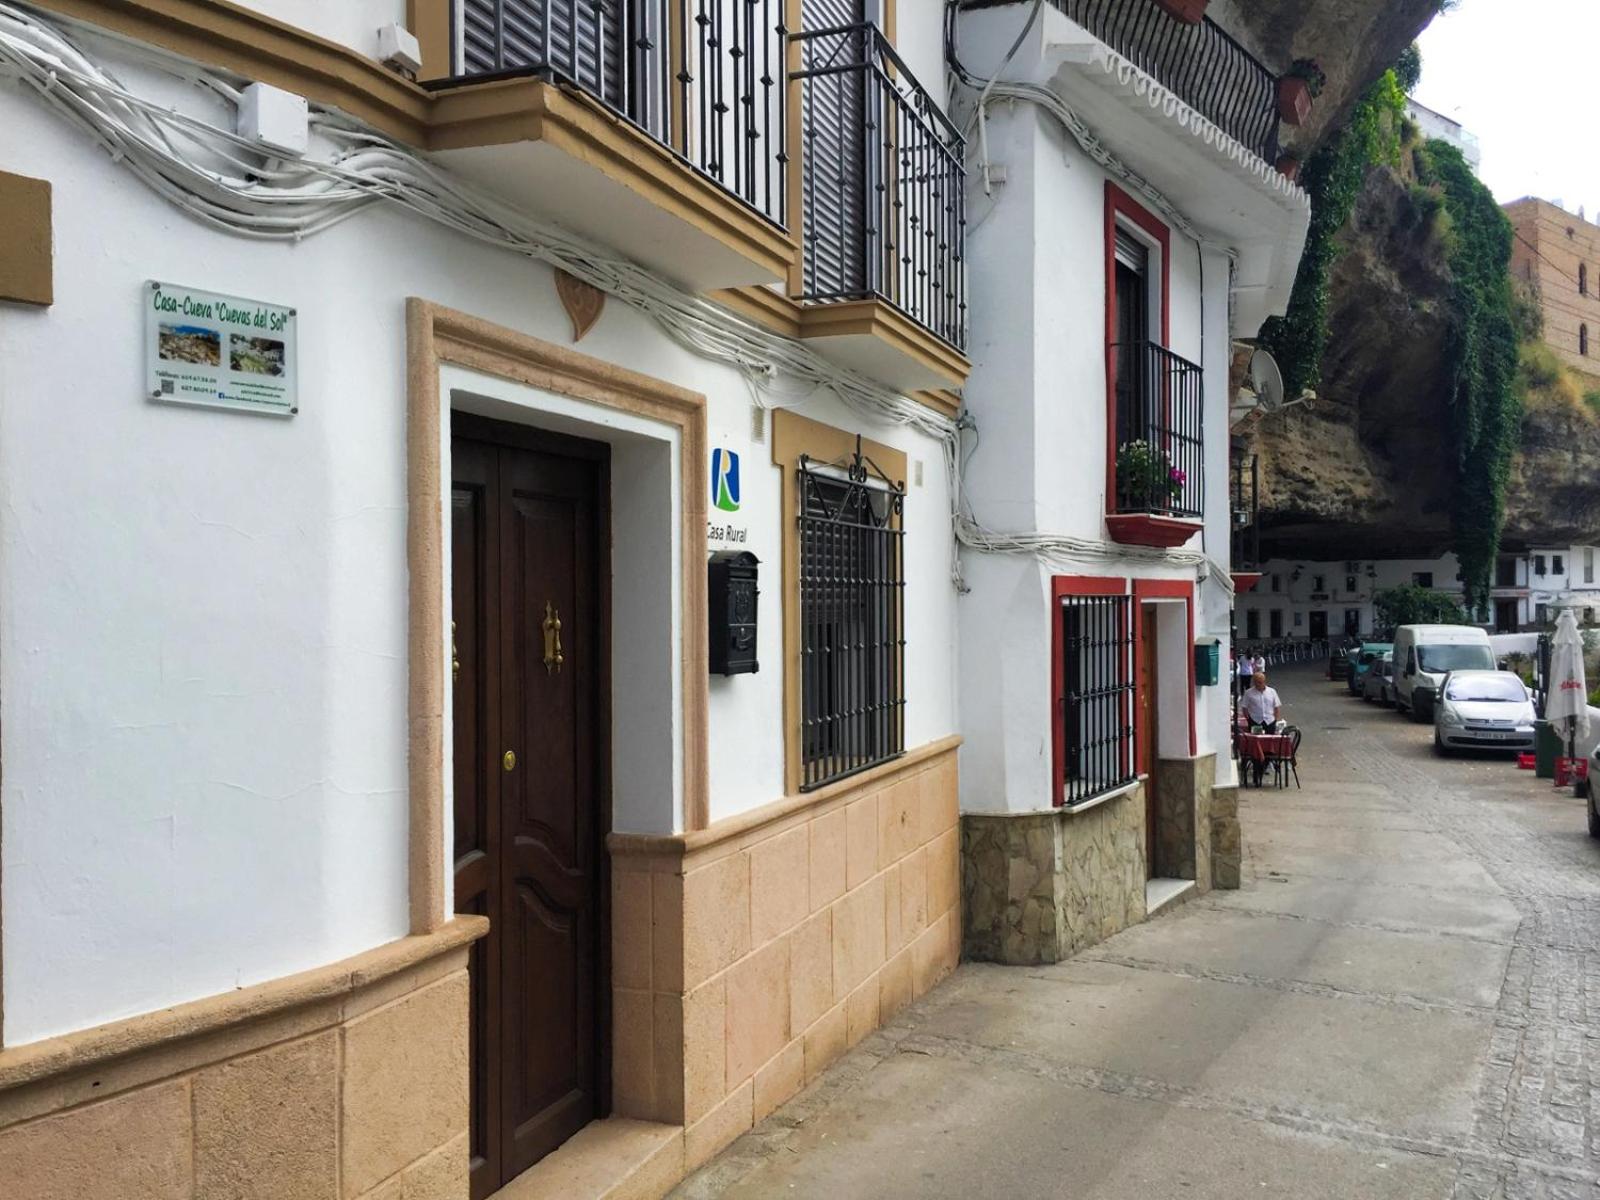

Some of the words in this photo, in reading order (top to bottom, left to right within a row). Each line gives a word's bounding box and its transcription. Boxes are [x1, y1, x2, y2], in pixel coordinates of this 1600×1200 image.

[154, 290, 212, 320] Casa-Cueva
[215, 302, 251, 326] "Cuevas
[254, 307, 267, 329] del
[270, 312, 287, 332] Sol"
[726, 524, 747, 543] Rural
